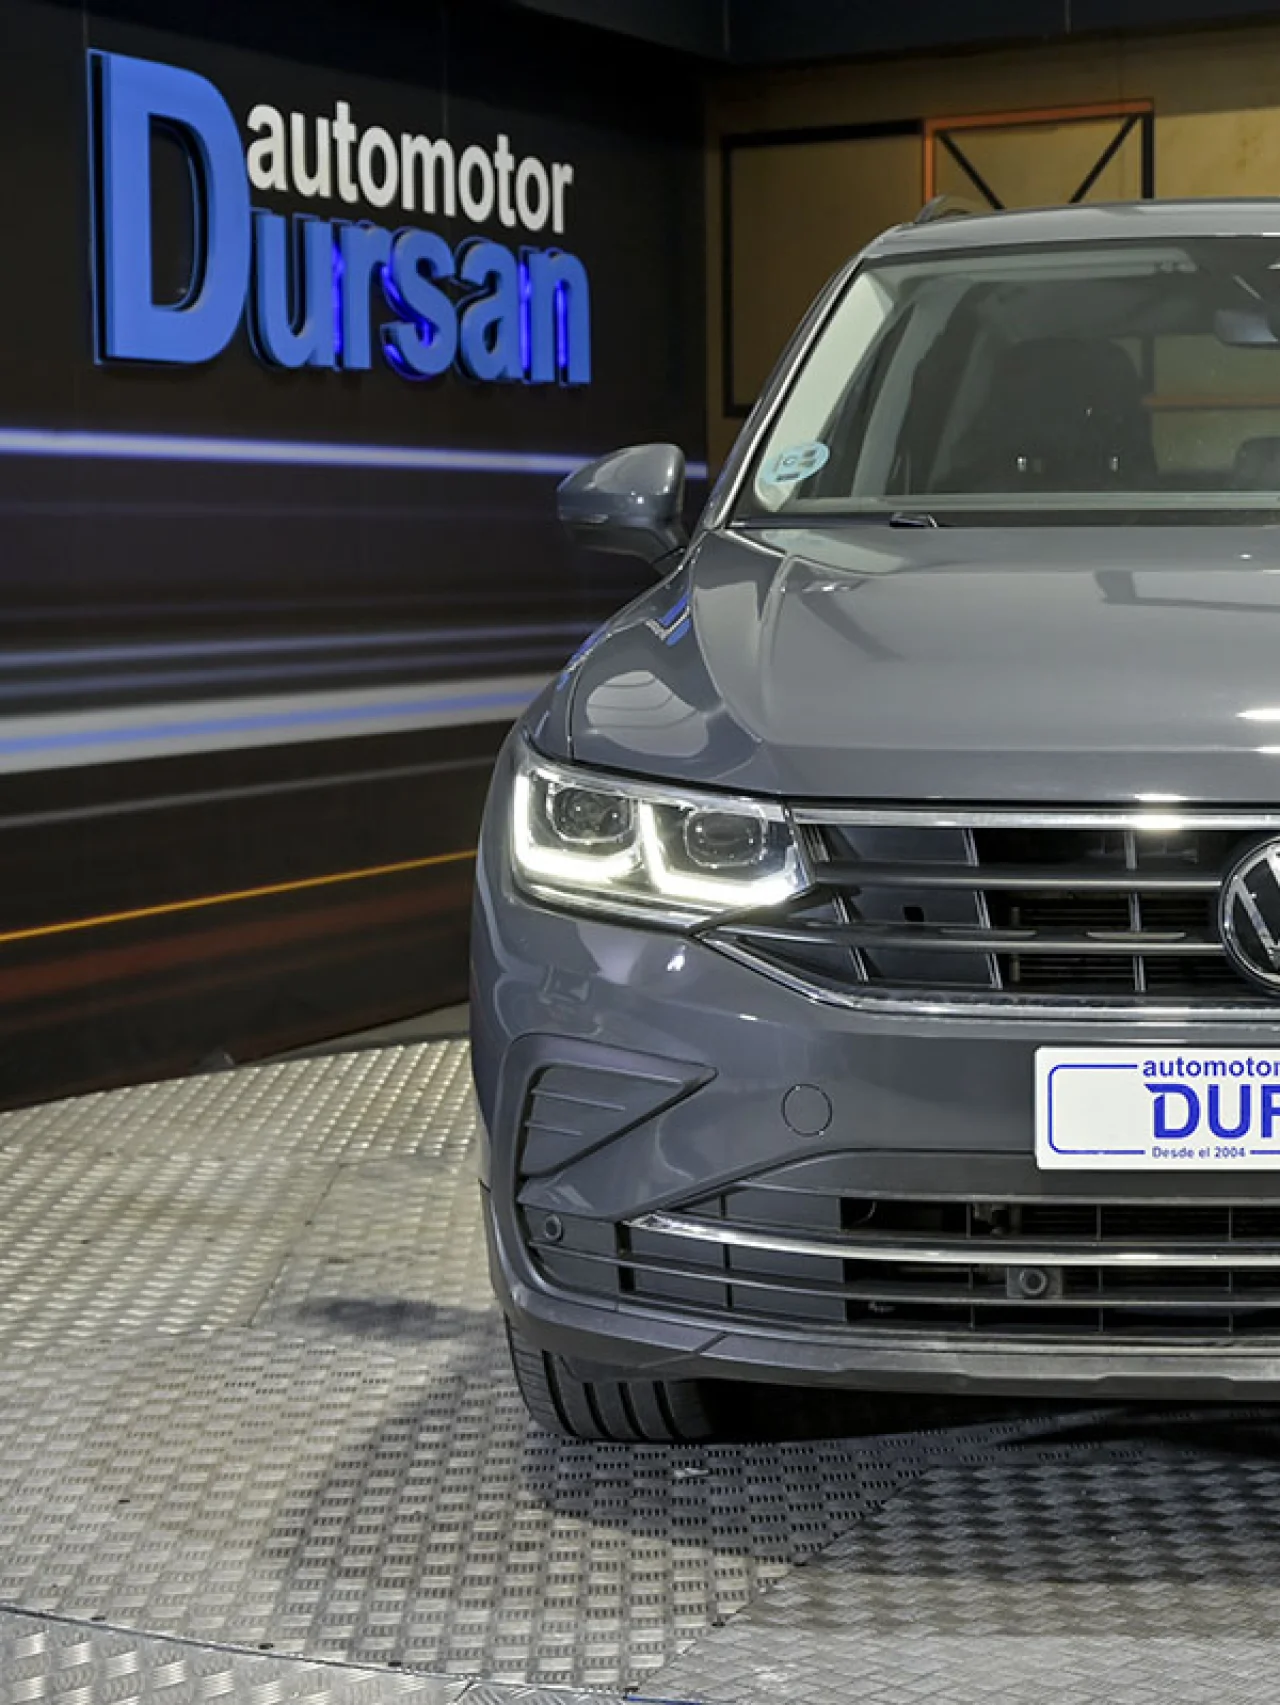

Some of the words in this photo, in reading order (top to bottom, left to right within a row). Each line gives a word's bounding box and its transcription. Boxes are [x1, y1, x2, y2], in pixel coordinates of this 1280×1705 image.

[88, 49, 592, 385] Dursan
[246, 101, 573, 233] automotor
[1152, 1146, 1195, 1158] Desde
[1198, 1146, 1210, 1158] el
[1213, 1146, 1247, 1158] 2004
